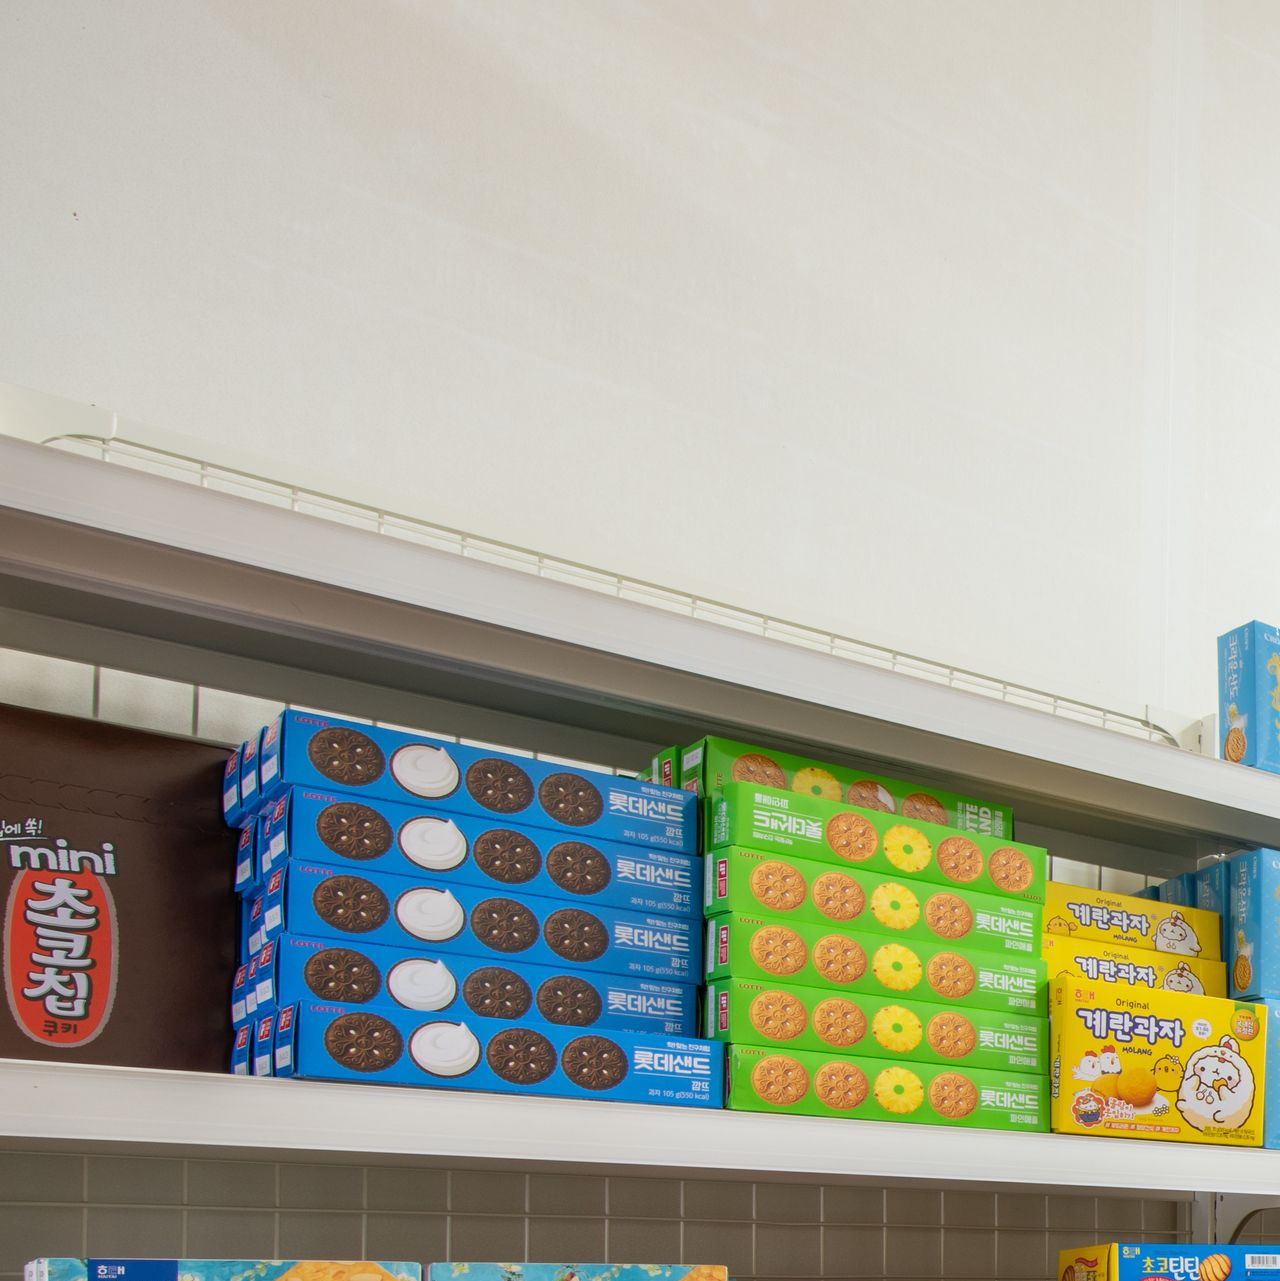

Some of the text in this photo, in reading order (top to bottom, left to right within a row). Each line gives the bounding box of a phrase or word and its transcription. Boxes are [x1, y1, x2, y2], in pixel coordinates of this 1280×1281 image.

[608, 791, 685, 822] 롯데샌드
[10, 838, 117, 876] mini
[616, 859, 692, 888] 롯데샌드
[1067, 902, 1150, 936] 계란과자
[23, 878, 98, 1018] 초코칩
[614, 924, 690, 953] 롯데샌드
[1075, 956, 1156, 988] 계란과자
[607, 991, 684, 1017] 롯데샌드
[1115, 998, 1150, 1011] Original
[42, 1019, 78, 1037] 쿠키
[1076, 1008, 1186, 1048] 계란과자
[634, 1049, 711, 1075] 롯데샌드
[1121, 1046, 1153, 1057] MOLANG
[662, 1089, 675, 1098] 105
[1142, 1256, 1200, 1281] 초코틴틴
